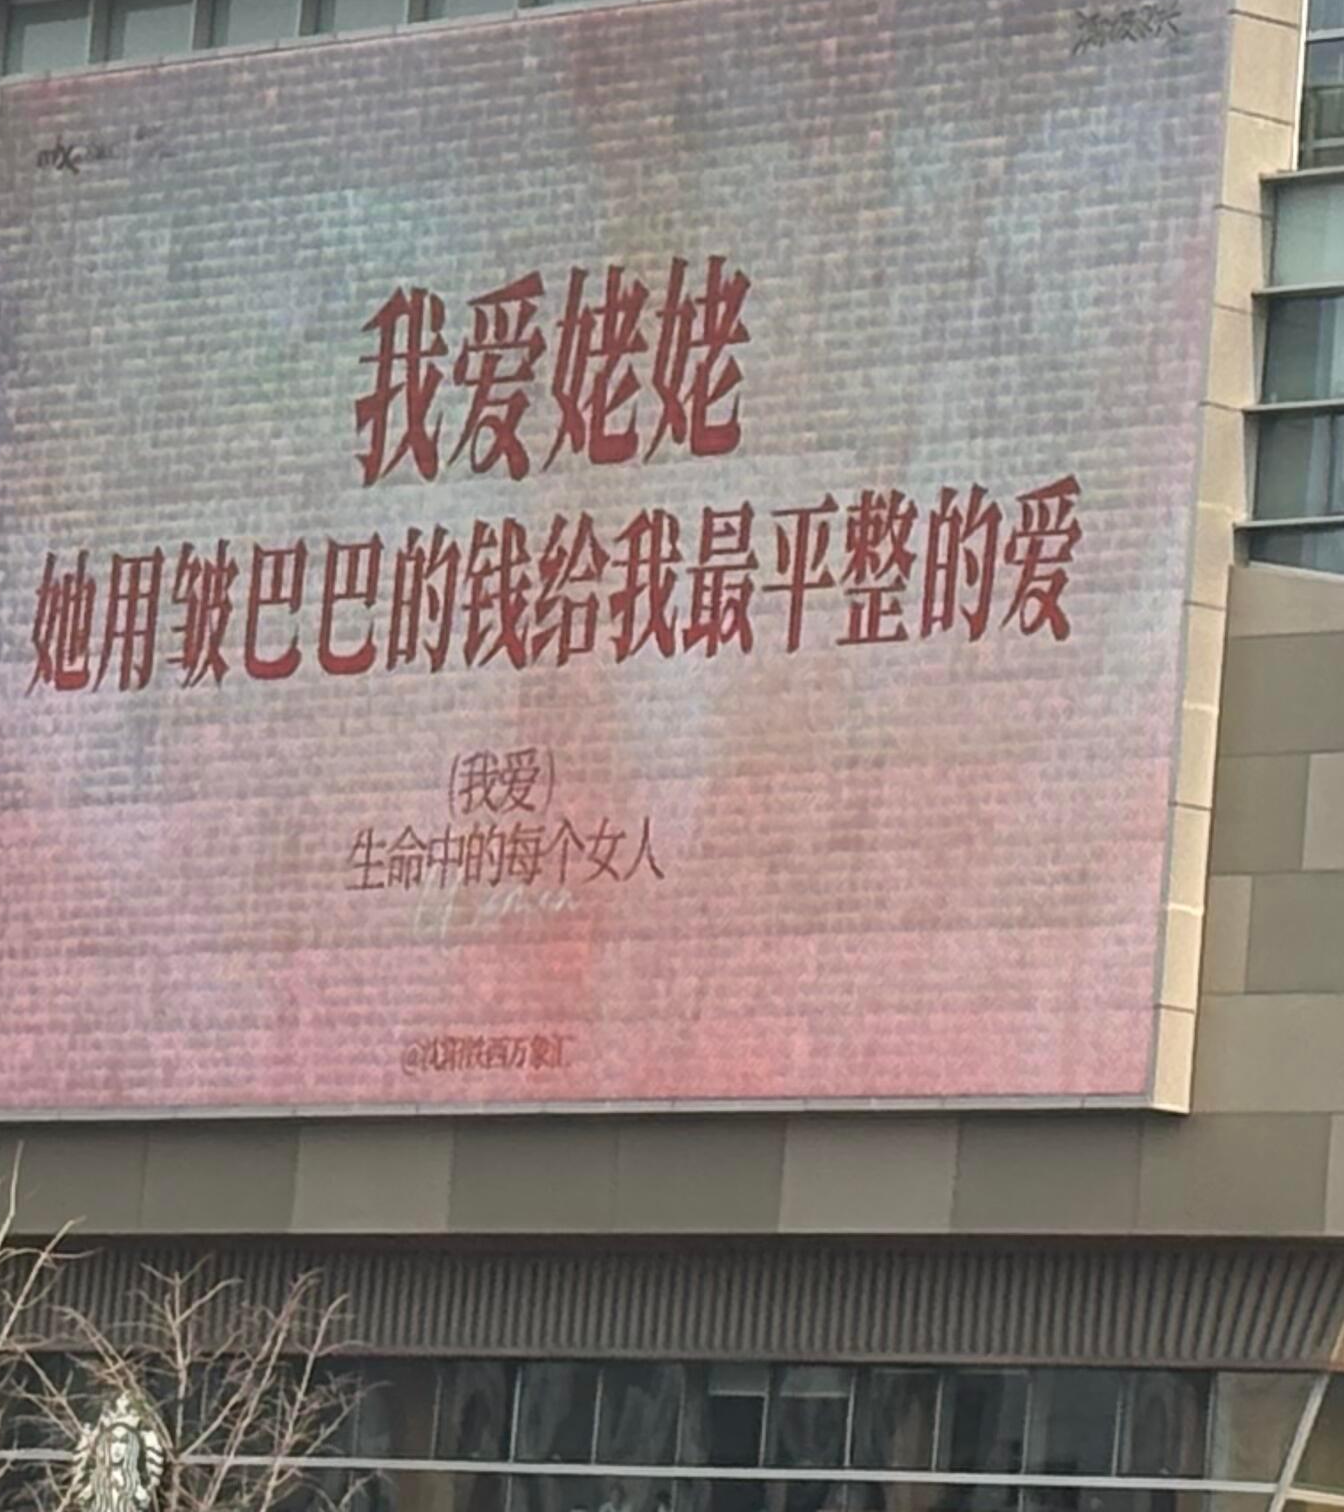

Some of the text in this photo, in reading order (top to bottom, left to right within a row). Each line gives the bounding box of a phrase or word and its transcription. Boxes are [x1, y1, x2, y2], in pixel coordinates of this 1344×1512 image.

[354, 255, 753, 487] 我爱姥姥
[28, 474, 1084, 696] 她用皱巴巴的钱给我最平整的爱
[346, 816, 665, 890] 生命中的每个女人
